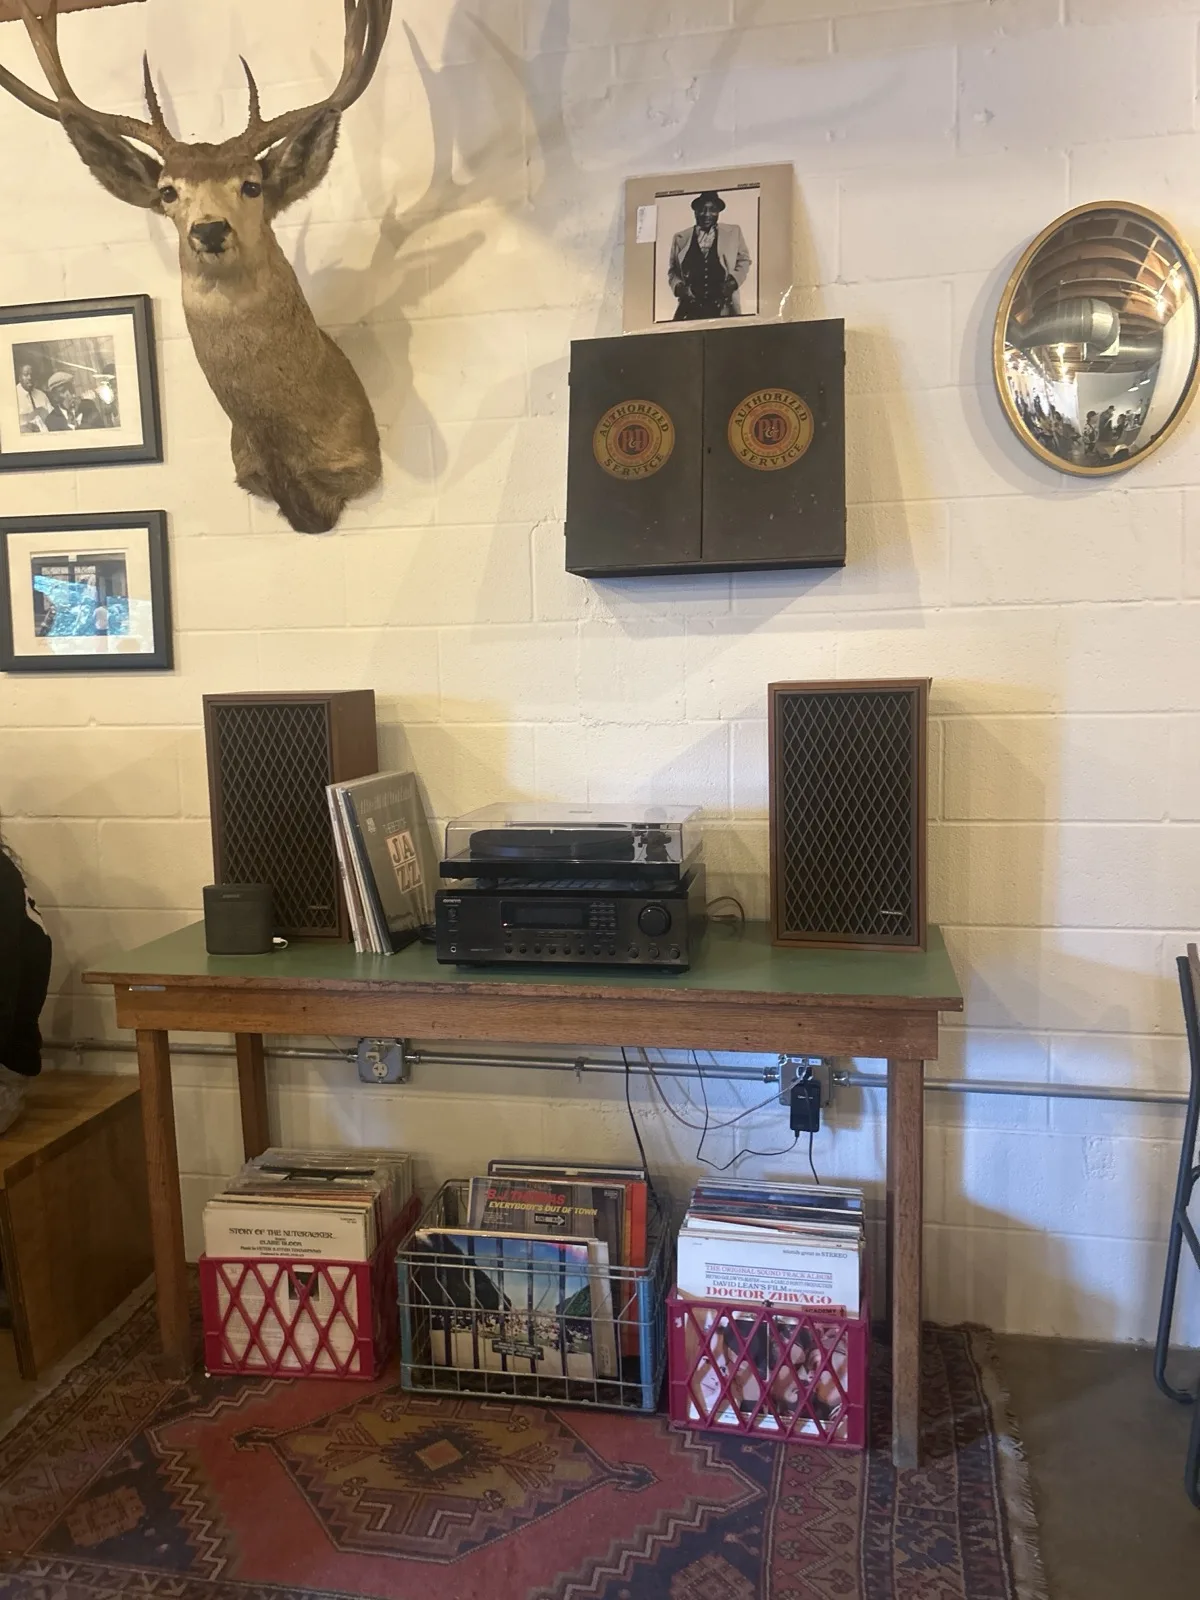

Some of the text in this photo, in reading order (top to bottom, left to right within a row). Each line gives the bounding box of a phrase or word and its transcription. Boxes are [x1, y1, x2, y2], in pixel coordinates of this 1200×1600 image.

[734, 392, 808, 428] AUTHORIZED
[599, 403, 669, 438] AUTHORIZED
[740, 443, 803, 467] SERVICE
[603, 454, 664, 476] SERVICE
[488, 1201, 599, 1216] EVERYBODY'S OUT OF TOWN
[228, 1227, 254, 1236] STORY
[267, 1229, 282, 1237] THE
[821, 1251, 848, 1259] STEREO
[721, 1266, 757, 1275] ORIGINAL
[757, 1268, 781, 1276] SOUND
[806, 1273, 833, 1281] ALBUM
[705, 1286, 765, 1299] DOCTOR
[737, 1281, 767, 1290] LEAN'S
[767, 1284, 788, 1292] FILM
